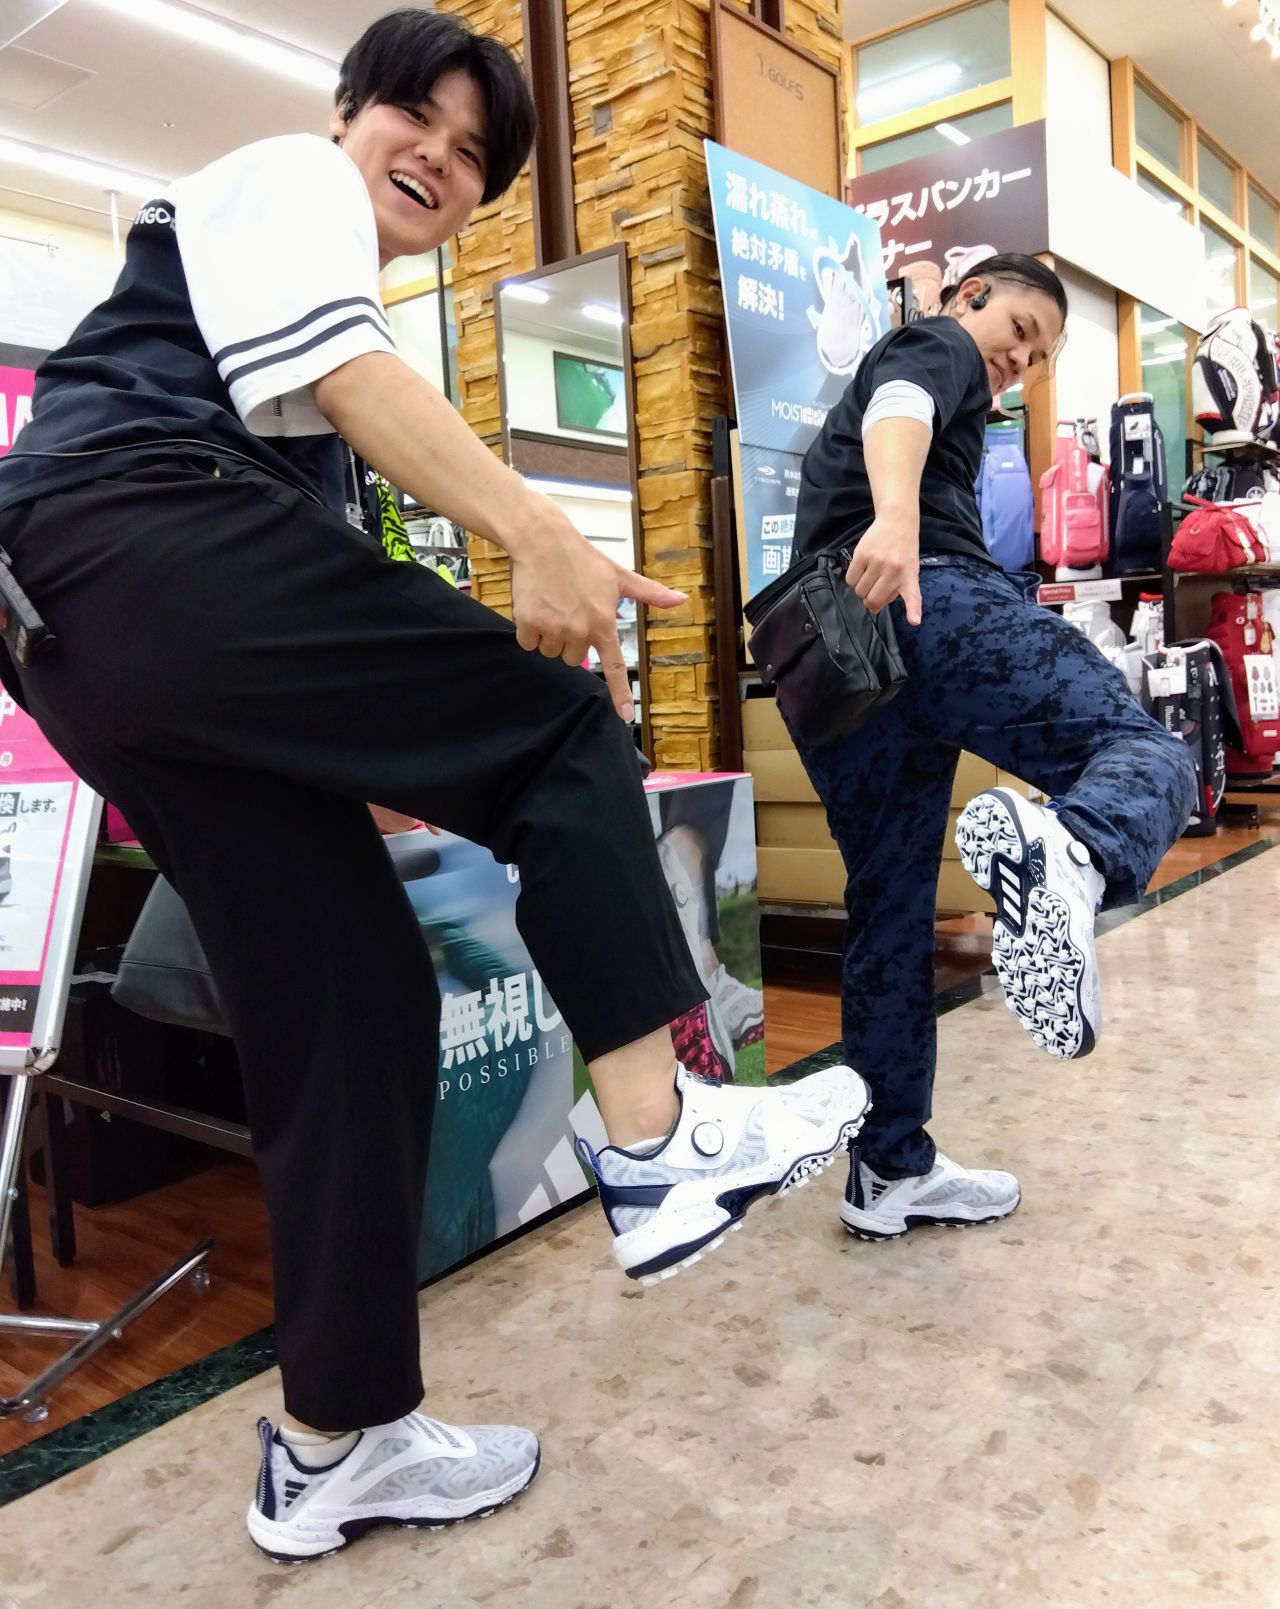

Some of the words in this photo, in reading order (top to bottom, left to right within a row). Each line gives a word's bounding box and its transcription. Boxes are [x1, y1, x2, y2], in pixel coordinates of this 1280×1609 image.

[854, 167, 1032, 229] ラスバンカー
[438, 1034, 570, 1101] POSSIBLE
